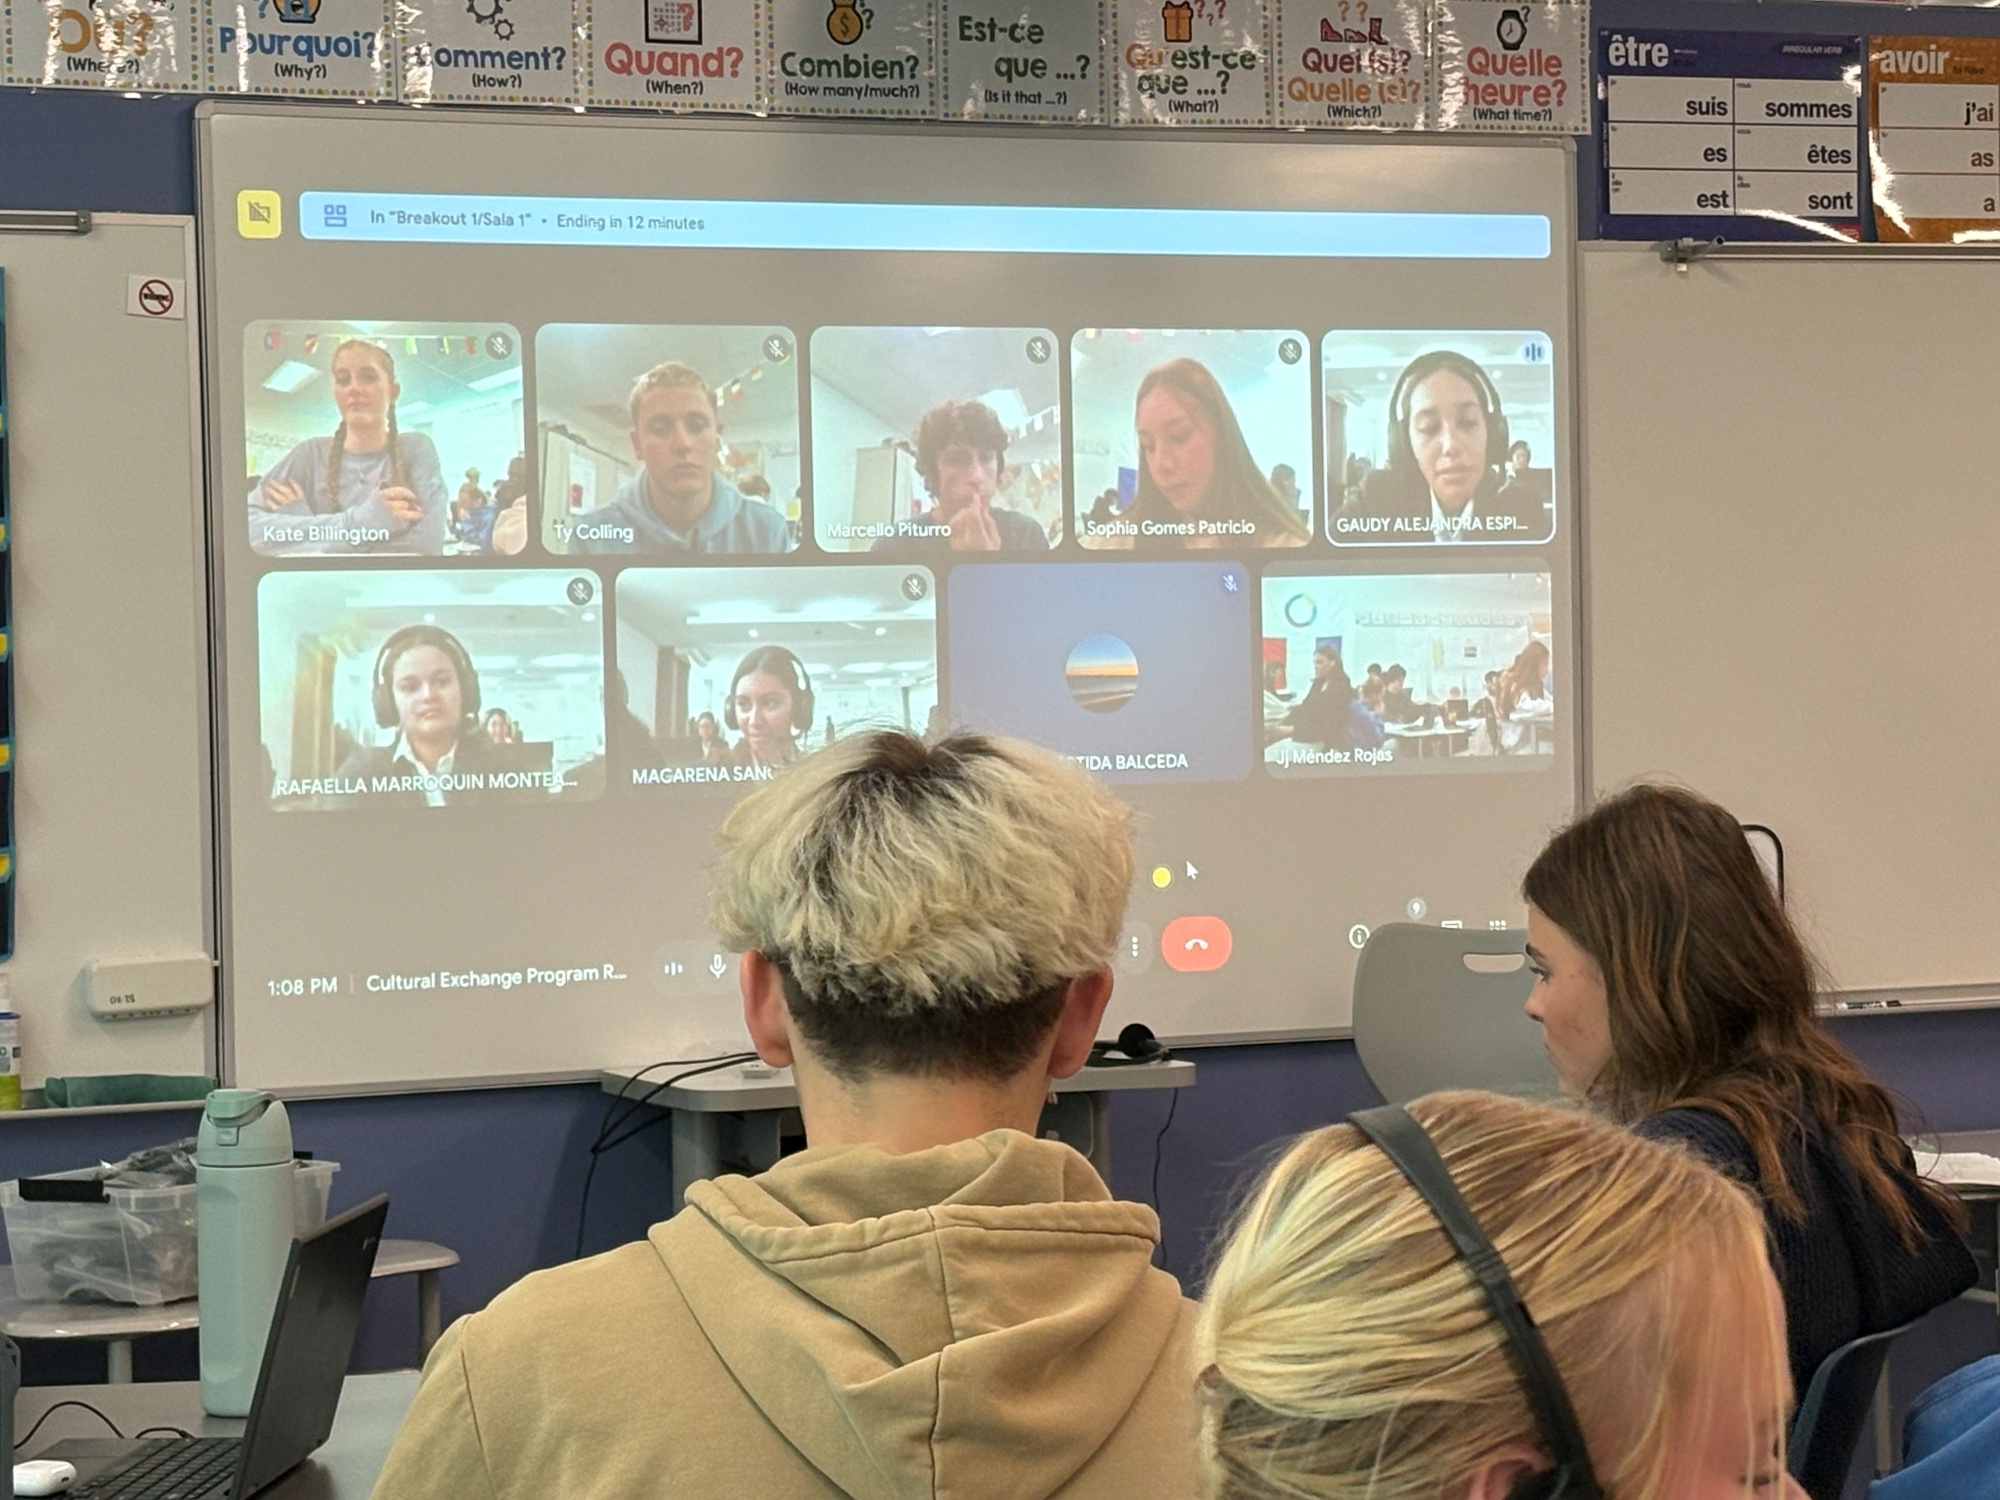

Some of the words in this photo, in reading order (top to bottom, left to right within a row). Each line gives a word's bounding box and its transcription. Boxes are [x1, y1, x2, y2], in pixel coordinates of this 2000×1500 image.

[958, 16, 1044, 44] Est-ce
[219, 27, 376, 62] Pourquoi?
[1609, 34, 1669, 67] être
[416, 43, 566, 71] omment?
[605, 42, 744, 78] Quand?
[780, 52, 919, 79] Combien?
[1467, 46, 1562, 77] Quelle
[1880, 45, 1950, 74] avoir
[274, 62, 327, 81] (Why?)
[995, 56, 1047, 83] que
[472, 73, 522, 89] (How?)
[646, 80, 703, 96] (When?)
[1137, 74, 1188, 98] que
[1287, 76, 1371, 103] Quelle
[785, 82, 820, 96] (How
[823, 84, 920, 100] many/much?)
[984, 89, 999, 103] (Is
[1002, 89, 1012, 103] it
[1015, 90, 1042, 104] that
[1463, 77, 1567, 107] heure?
[1169, 100, 1219, 113] (What?)
[1327, 104, 1382, 118] (Which?)
[1473, 107, 1510, 121] (What
[1513, 108, 1553, 122] time?)
[1686, 96, 1728, 115] suis
[1765, 100, 1852, 119] sommes
[1964, 102, 1995, 126] j'ai
[1703, 146, 1728, 162] es
[1807, 145, 1852, 164] êtes
[1971, 150, 1995, 167] as
[1697, 191, 1729, 208] est
[1808, 194, 1853, 210] sont
[1983, 195, 1996, 212] a
[371, 210, 385, 224] In
[472, 211, 515, 227] 1/Sala
[557, 213, 606, 231] Ending
[609, 214, 622, 229] in
[627, 215, 644, 229] 12
[648, 216, 705, 231] minutes
[553, 524, 574, 544] Ty
[576, 523, 634, 543] Colling
[827, 521, 895, 538] Marcello
[898, 521, 952, 538] Piturro
[1087, 520, 1139, 539] Sophia
[1141, 520, 1195, 536] Gomes
[1199, 520, 1256, 536] Patricio
[1337, 518, 1390, 533] GAUDY
[1393, 517, 1482, 533] ALEJANDRA
[263, 526, 304, 542] Kate
[309, 525, 389, 545] Billington
[1116, 753, 1188, 770] BALCEDA
[1293, 747, 1351, 764] Méndez
[1354, 746, 1394, 765] Rojas
[276, 777, 368, 796] RAFAELLA
[372, 774, 484, 793] MARROQUIN
[267, 979, 304, 996] 1:08
[311, 977, 338, 994] PM
[366, 973, 436, 992] Cultural
[440, 968, 522, 990] Exchange
[527, 965, 598, 986] Program
